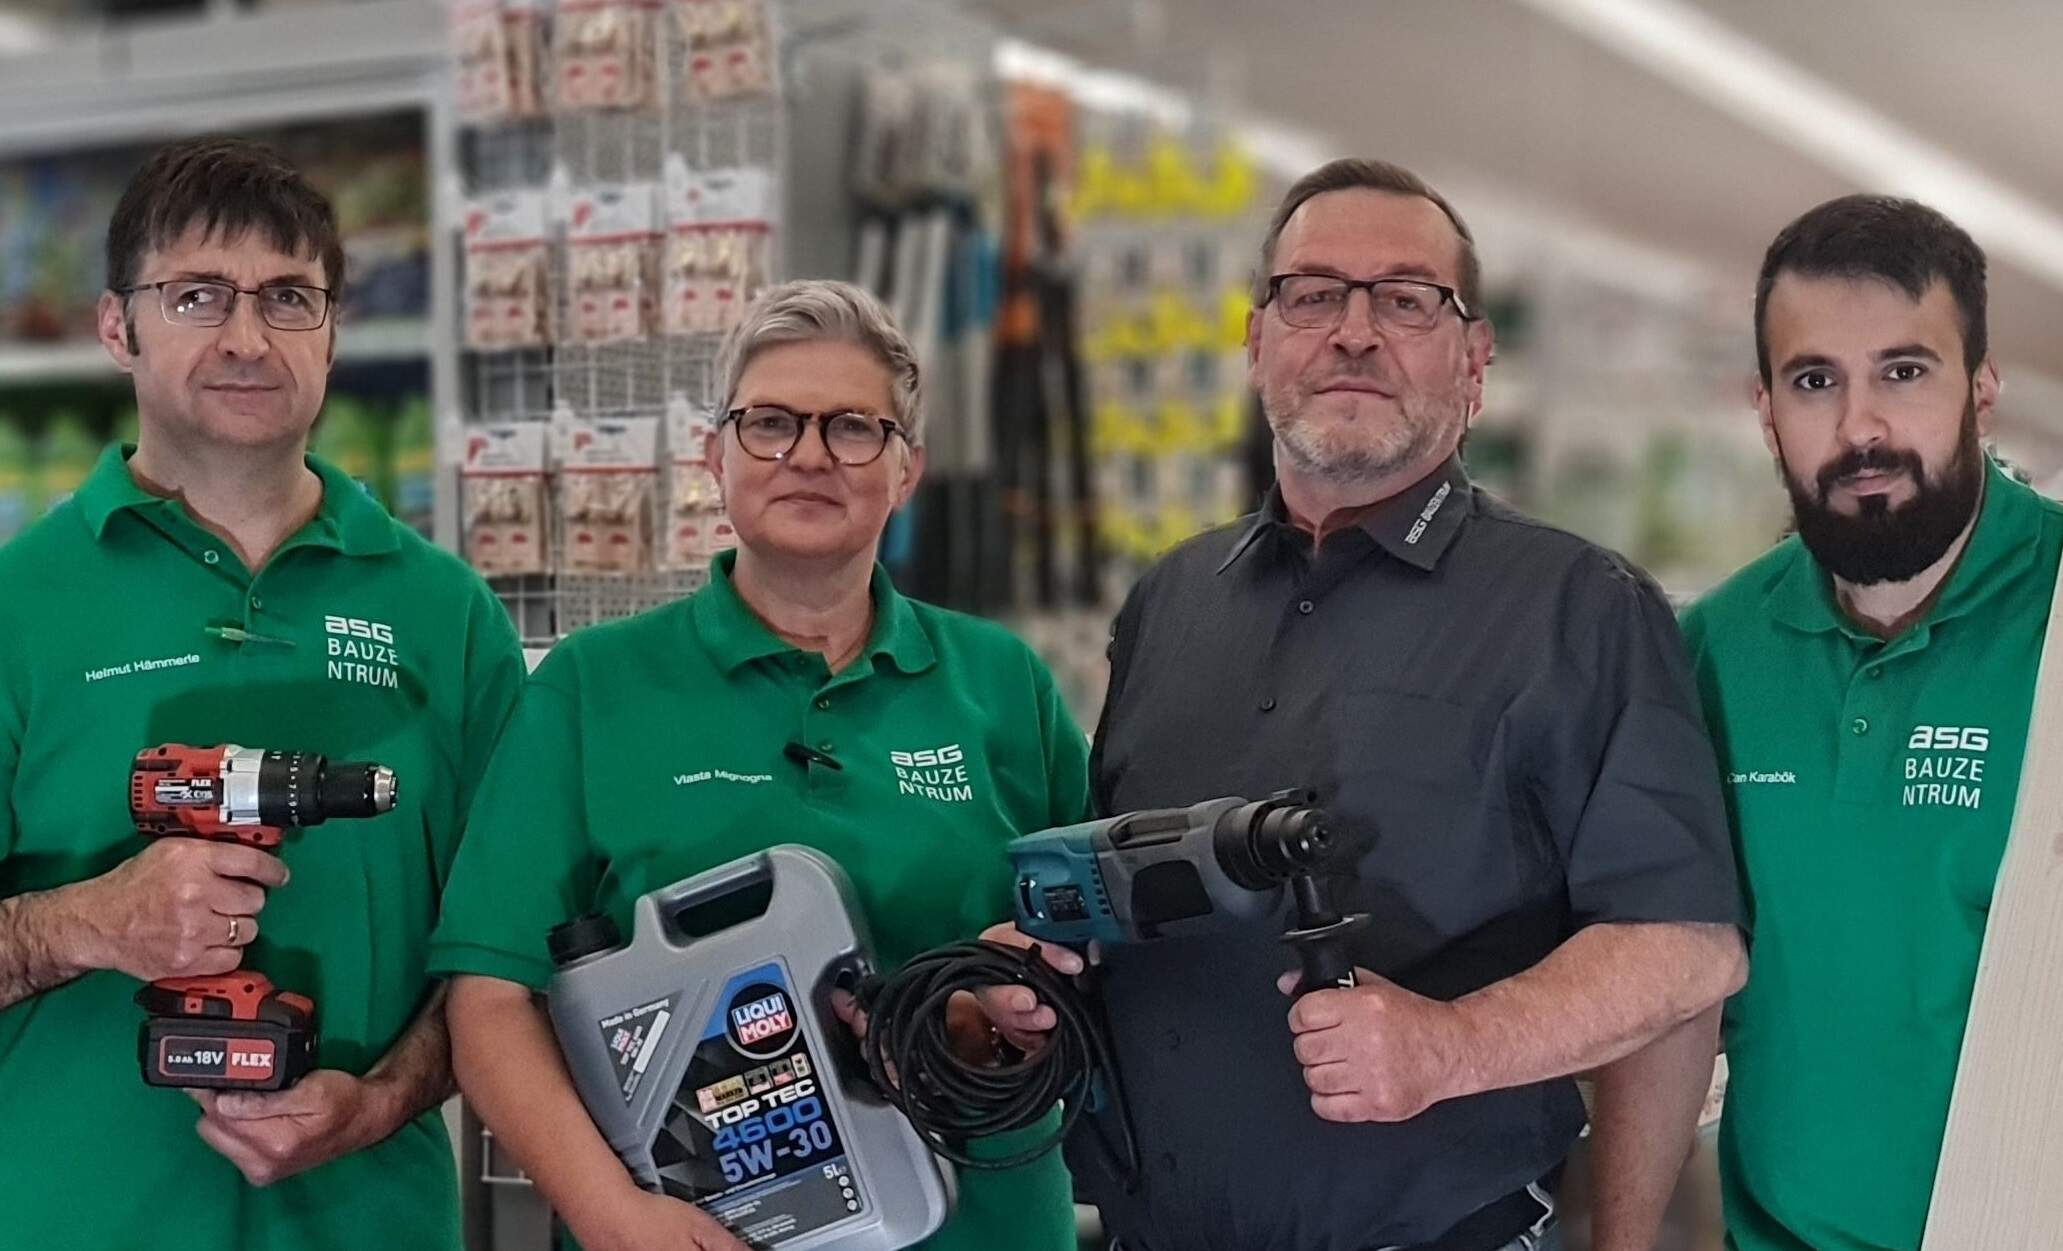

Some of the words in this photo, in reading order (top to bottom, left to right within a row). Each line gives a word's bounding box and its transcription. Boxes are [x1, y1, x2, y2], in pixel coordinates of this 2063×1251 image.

[327, 637, 399, 666] BAUZE
[85, 663, 131, 682] Helmut
[133, 653, 200, 672] Hämmerle
[328, 660, 398, 689] NTRUM
[673, 771, 712, 786] Vlasta
[714, 769, 773, 784] Mignogna
[895, 764, 969, 785] BAUZE
[1749, 770, 1797, 784] Karabök
[1905, 756, 1985, 782] BAUZE
[899, 779, 974, 802] NTRUM
[1903, 783, 1981, 809] NTRUM
[735, 996, 784, 1026] LIQUI
[740, 1012, 789, 1044] MOLY
[194, 1050, 225, 1065] 18V
[231, 1052, 273, 1067] FLEX
[704, 1099, 760, 1129] TOP
[761, 1078, 816, 1108] TEC
[712, 1096, 822, 1151] 4600
[719, 1120, 833, 1183] 5W-30
